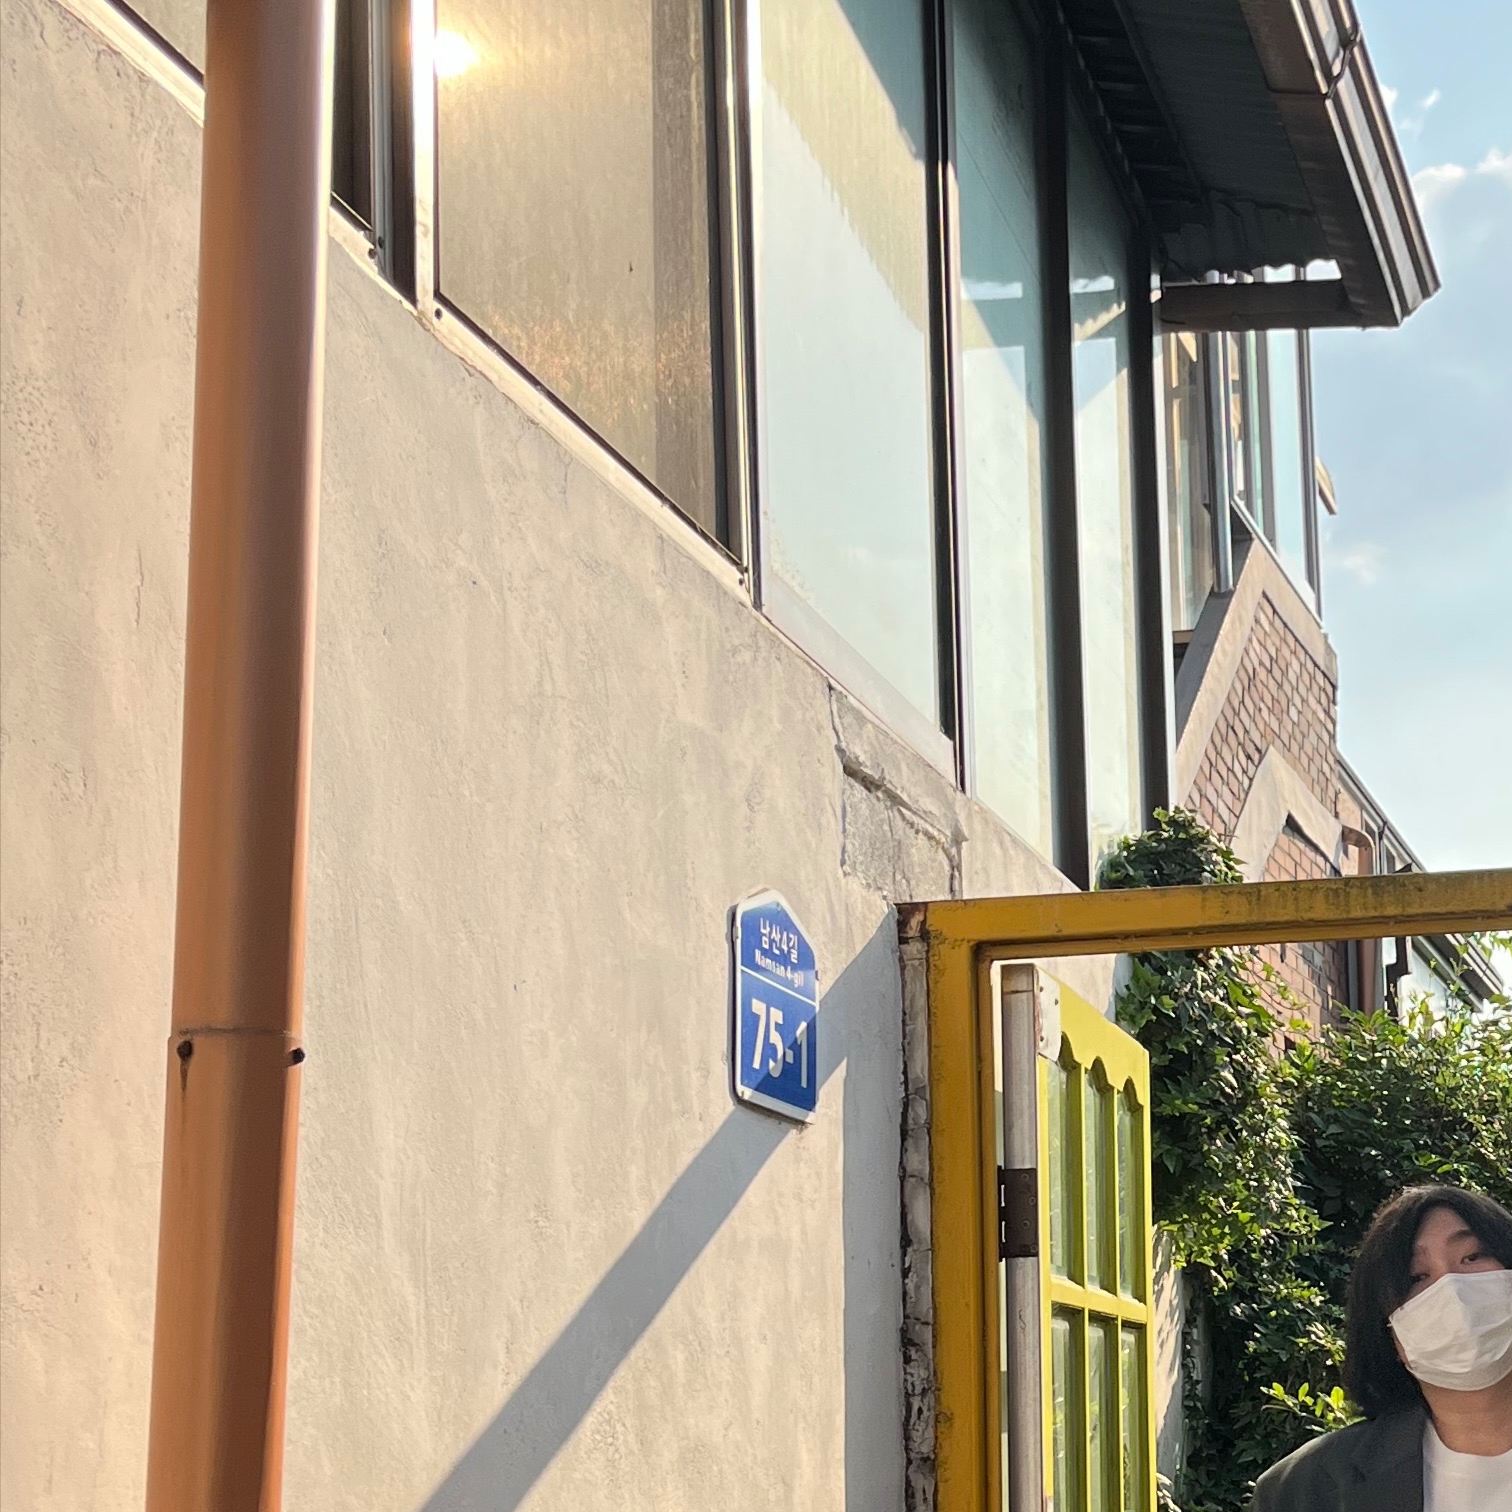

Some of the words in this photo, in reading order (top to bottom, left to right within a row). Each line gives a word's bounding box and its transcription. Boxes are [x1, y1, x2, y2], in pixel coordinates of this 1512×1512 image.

[760, 918, 798, 964] 남산4길
[755, 949, 786, 979] Namsan
[786, 966, 805, 988] 4-gil
[752, 998, 808, 1088] 75-1
